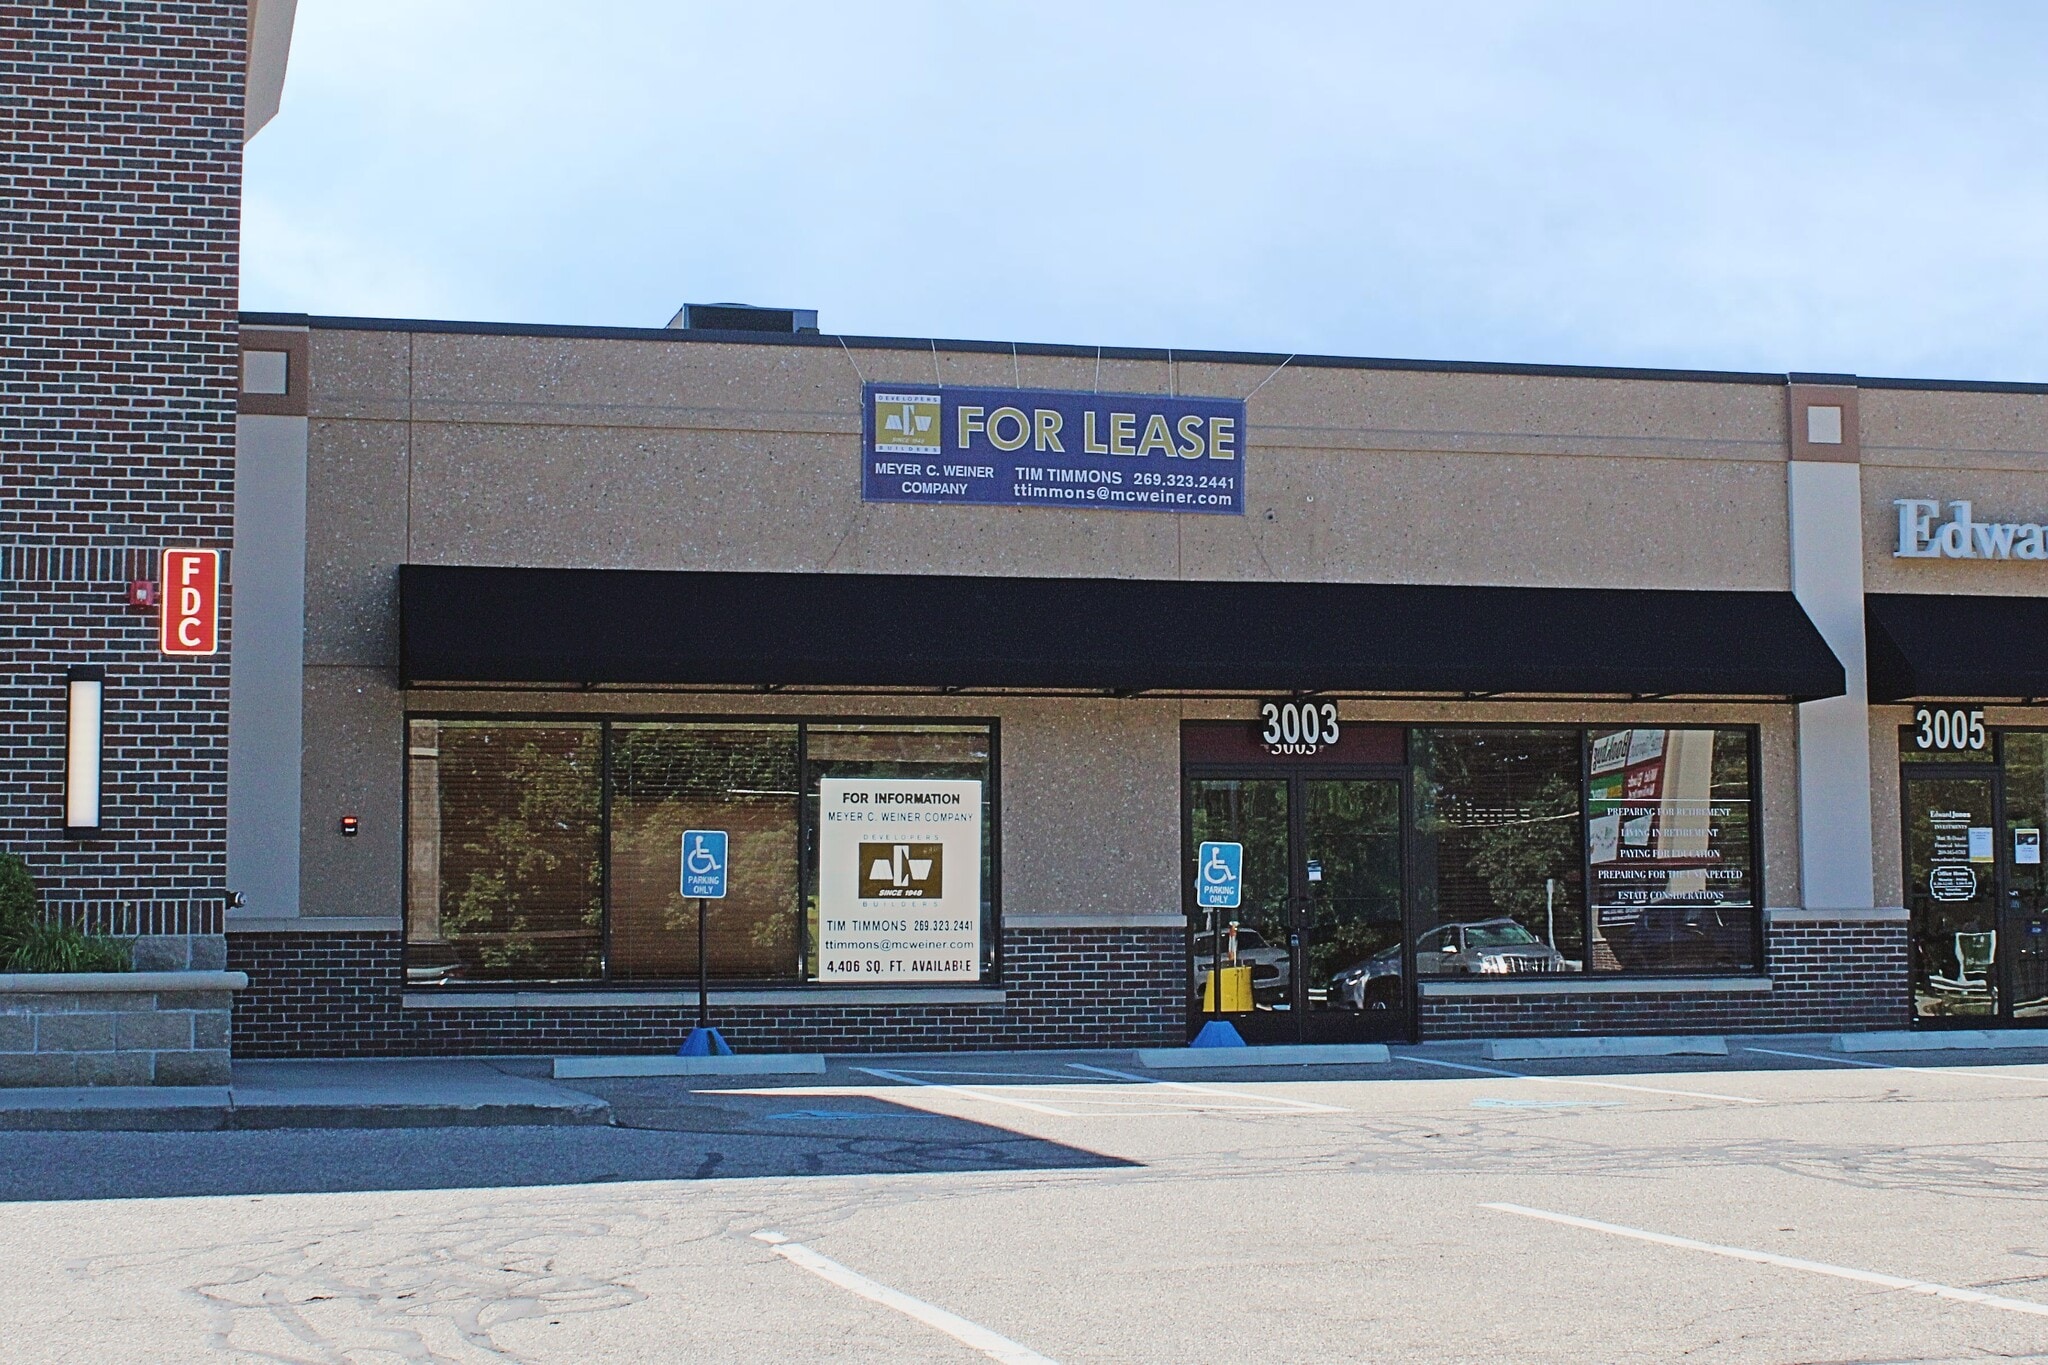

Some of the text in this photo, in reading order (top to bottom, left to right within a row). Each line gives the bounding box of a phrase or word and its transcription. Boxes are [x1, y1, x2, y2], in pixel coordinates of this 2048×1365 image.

[878, 395, 937, 403] DEVELOPERS
[957, 405, 1235, 461] FOR LEASE
[878, 445, 937, 453] BUILDERS
[875, 462, 994, 478] MEYER C. WEINER
[1015, 467, 1234, 490] TIM TIMMONS 269.323.2441
[901, 481, 968, 495] COMPANY
[1013, 483, 1232, 506] ttimmons@mcweiner.com
[1892, 498, 2048, 560] Edwa
[1262, 703, 1340, 744] 3003
[1916, 708, 1986, 750] 3005
[842, 792, 960, 805] FOR INFORMATION
[828, 811, 973, 822] MEYER C. WEINER COMPANY
[1607, 807, 1732, 816] PREPARING FOR RETIREMENT
[1620, 828, 1719, 837] LIVING IN RETIREMENT
[1620, 849, 1721, 858] PAYING FOR EDUCATION
[687, 875, 720, 885] PARKING
[1598, 870, 1647, 879] PREPARING
[1648, 870, 1666, 879] FOR
[693, 885, 714, 894] ONLY
[878, 889, 904, 897] SINCE
[1203, 885, 1235, 895] PARKING
[1209, 895, 1229, 904] ONLY
[1618, 891, 1725, 900] ESTATE CONSIDERATIONS
[827, 920, 973, 932] TIM TIMMONS 269.323.2441
[825, 939, 974, 952] ttimmons@mcweiner.com
[827, 960, 860, 973] 4,406
[866, 960, 884, 974] SQ.
[890, 960, 906, 972] FT.
